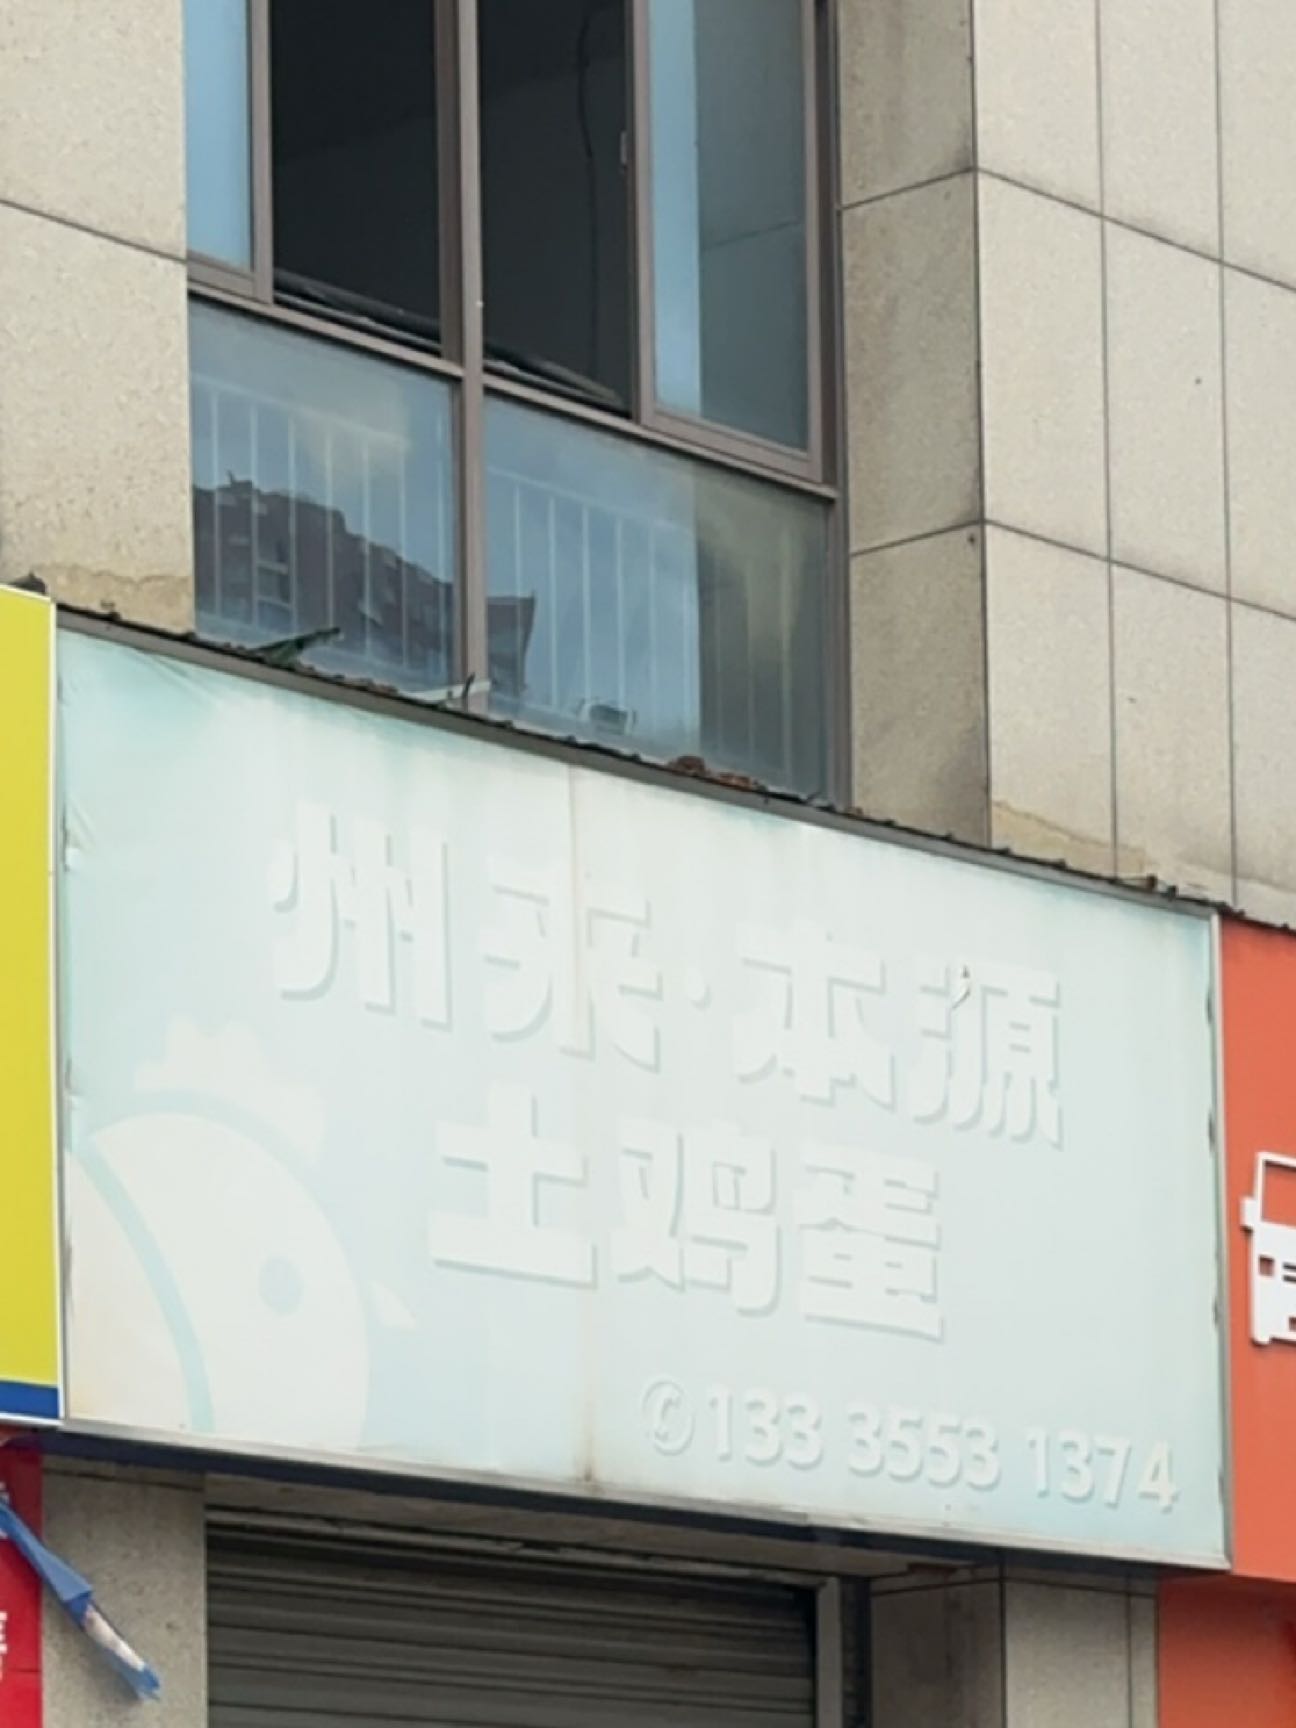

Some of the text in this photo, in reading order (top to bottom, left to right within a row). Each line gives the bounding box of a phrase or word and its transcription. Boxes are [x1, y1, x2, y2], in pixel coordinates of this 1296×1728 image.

[428, 1085, 946, 1342] 土鸡蛋
[706, 1382, 1182, 1515] 133 3553 1374
